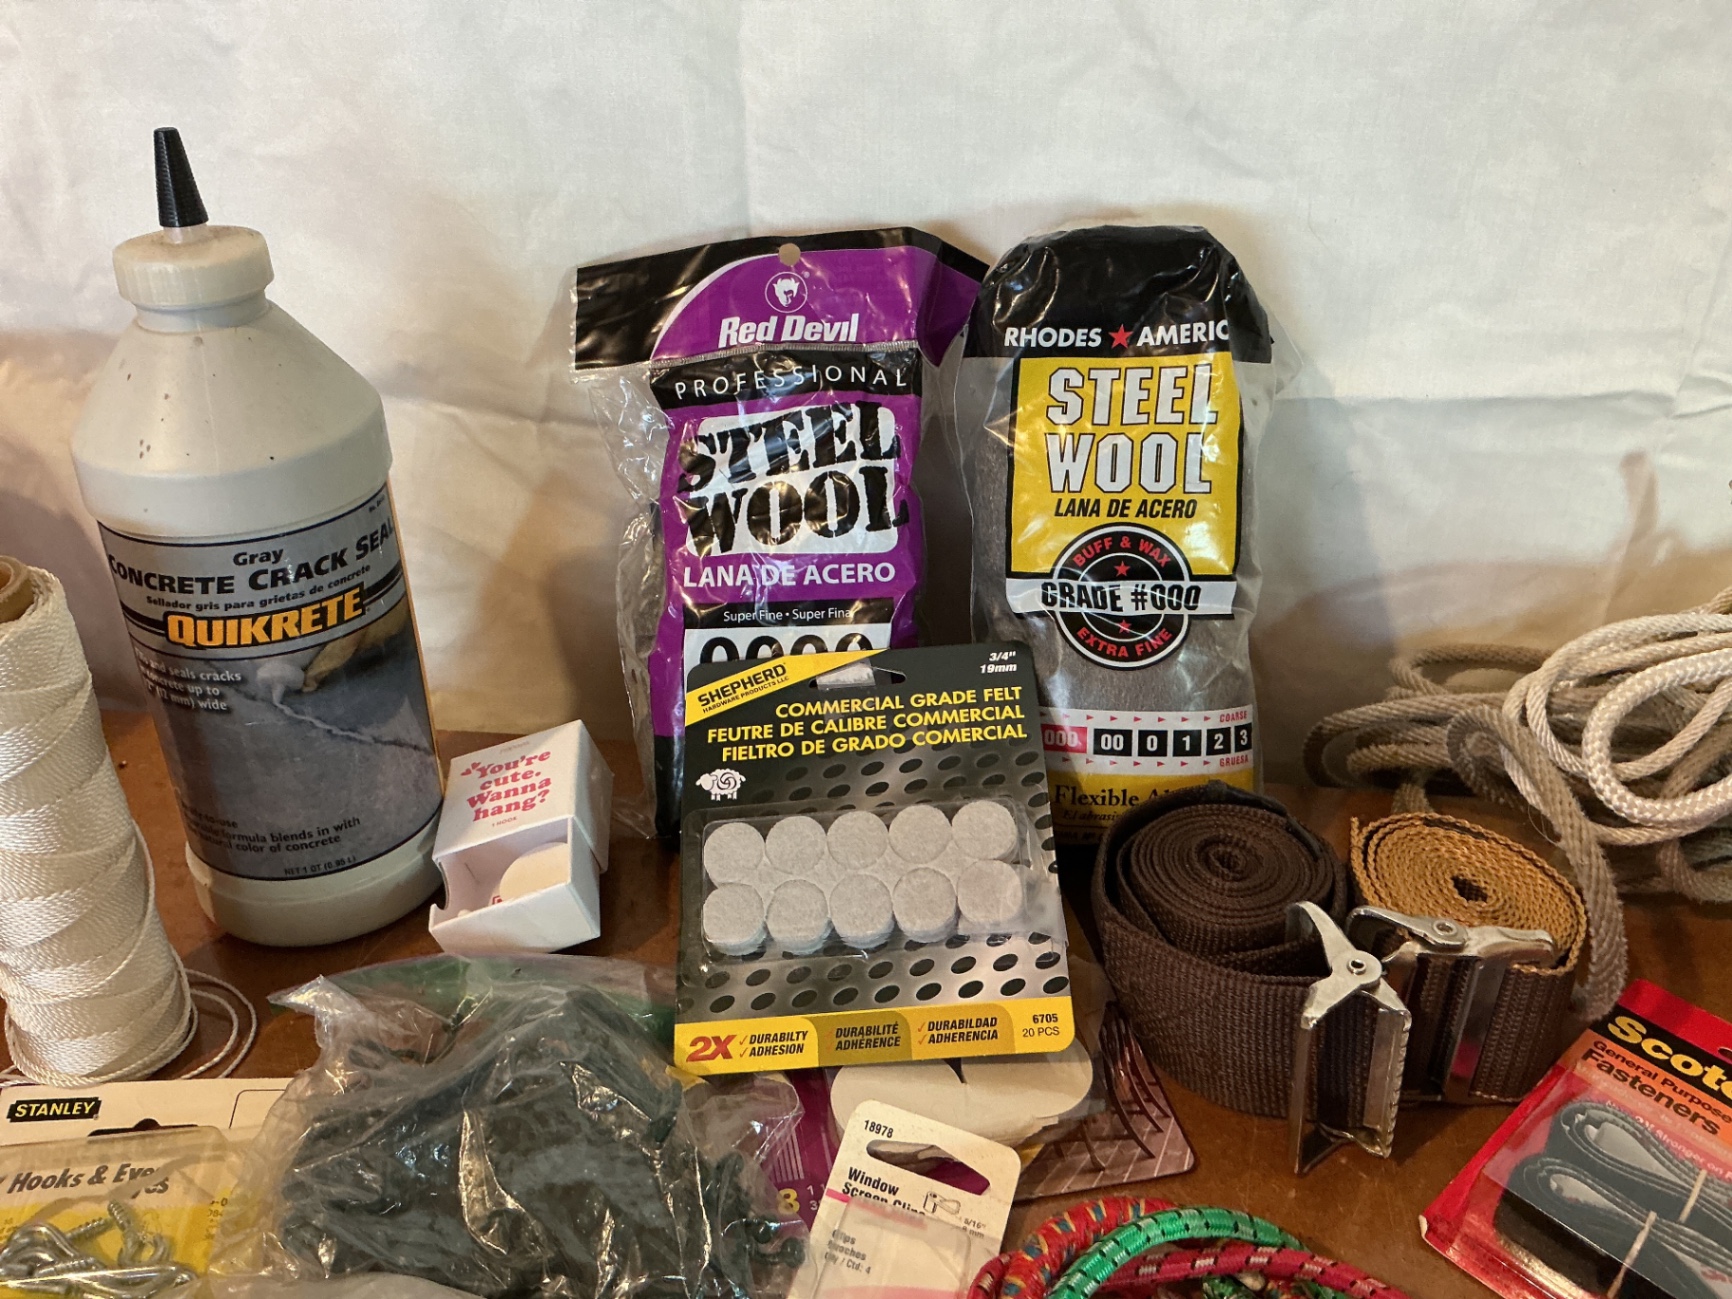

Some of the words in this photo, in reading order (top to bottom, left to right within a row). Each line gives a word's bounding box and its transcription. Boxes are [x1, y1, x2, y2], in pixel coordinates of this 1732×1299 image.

[718, 316, 778, 348] Red
[781, 313, 859, 342] Devil
[1004, 327, 1102, 348] RHODES
[675, 365, 908, 400] PROFESSIONAL
[1046, 363, 1218, 426] STEEL
[677, 400, 901, 493] STEEL
[1045, 432, 1212, 494] WOOL
[674, 466, 909, 557] WOOL
[1054, 499, 1101, 517] LANA
[1107, 499, 1132, 517] DE
[1136, 499, 1197, 519] ACERO
[233, 549, 284, 567] Gray
[1072, 537, 1113, 568] BUFF
[1119, 536, 1131, 549] &
[1139, 538, 1172, 568] WAX
[108, 553, 235, 595] CONCRETE
[249, 548, 348, 590] CRACK
[684, 563, 754, 588] LANA
[760, 564, 796, 586] DE
[803, 562, 896, 585] ACERO
[147, 596, 191, 610] Sellador
[195, 602, 220, 611] gris
[224, 600, 254, 611] para
[260, 591, 305, 608] grietas
[309, 585, 324, 596] de
[1041, 582, 1123, 612] GRADE
[1131, 583, 1201, 611] #000
[167, 587, 363, 648] QUIKRETE
[723, 611, 756, 623] Super
[760, 609, 783, 621] Fine
[792, 608, 824, 621] Super
[828, 607, 852, 619] Fina
[1076, 626, 1129, 658] EXTRA
[1136, 627, 1173, 656] FINE
[979, 663, 1017, 675] 19mm
[989, 650, 1016, 662] 3/4"
[168, 666, 196, 679] seals
[200, 670, 242, 682] cracks
[697, 663, 787, 707] SHEPHERD
[170, 694, 195, 709] mm)
[198, 699, 228, 710] wide
[187, 684, 202, 697] up
[207, 685, 220, 696] to
[702, 695, 740, 714] HARDWARE
[741, 681, 776, 699] PRODUCTS
[777, 676, 789, 687] LLC
[775, 695, 904, 719] COMMERCIAL
[910, 689, 976, 708] GRADE
[984, 686, 1022, 703] FELT
[707, 724, 773, 743] FEUTRE
[780, 721, 804, 737] DE
[815, 716, 886, 734] CALIBRE
[893, 705, 1025, 728] COMMERCIAL
[1219, 710, 1247, 723] COARSE
[722, 741, 795, 762] FIELTRO
[801, 739, 825, 755] DE
[832, 734, 906, 753] GRADO
[912, 724, 1027, 746] COMERCIAL
[1100, 733, 1124, 751] 00
[1146, 735, 1158, 751] 0
[1182, 735, 1190, 751] 1
[1214, 733, 1224, 750] 2
[1240, 730, 1248, 746] 3
[475, 751, 551, 778] You're
[1219, 755, 1249, 767] GRUESA
[467, 777, 551, 809] Wanna
[480, 770, 541, 790] cute.
[473, 789, 550, 821] hang?
[1055, 784, 1140, 806] Flexible
[222, 829, 267, 843] formula
[270, 830, 314, 843] blends
[317, 827, 330, 839] in
[333, 817, 361, 832] with
[236, 843, 265, 853] color
[270, 841, 282, 853] of
[286, 834, 341, 852] concrete
[284, 867, 300, 875] NET
[835, 1021, 899, 1038] DURABILITÉ
[927, 1017, 998, 1032] DURABILDAD
[1033, 1014, 1058, 1024] 6705
[749, 1030, 809, 1044] DURABILTY
[928, 1029, 999, 1044] ADHERENCIA
[1022, 1028, 1034, 1038] 20
[1037, 1027, 1060, 1037] PCS
[686, 1034, 737, 1062] 2X
[749, 1043, 805, 1057] ADHESION
[1581, 1048, 1721, 1135] Fasteners
[1593, 1041, 1658, 1080] General
[1661, 1077, 1732, 1123] Purpose
[15, 1101, 96, 1117] STANLEY
[863, 1119, 894, 1138] 18978
[1655, 1129, 1705, 1164] Stronger
[1707, 1160, 1724, 1175] on
[7, 1168, 85, 1194] Hooks
[87, 1164, 109, 1185] &
[848, 1166, 899, 1196] Window
[777, 1188, 800, 1215] 8
[968, 1229, 985, 1239] mm
